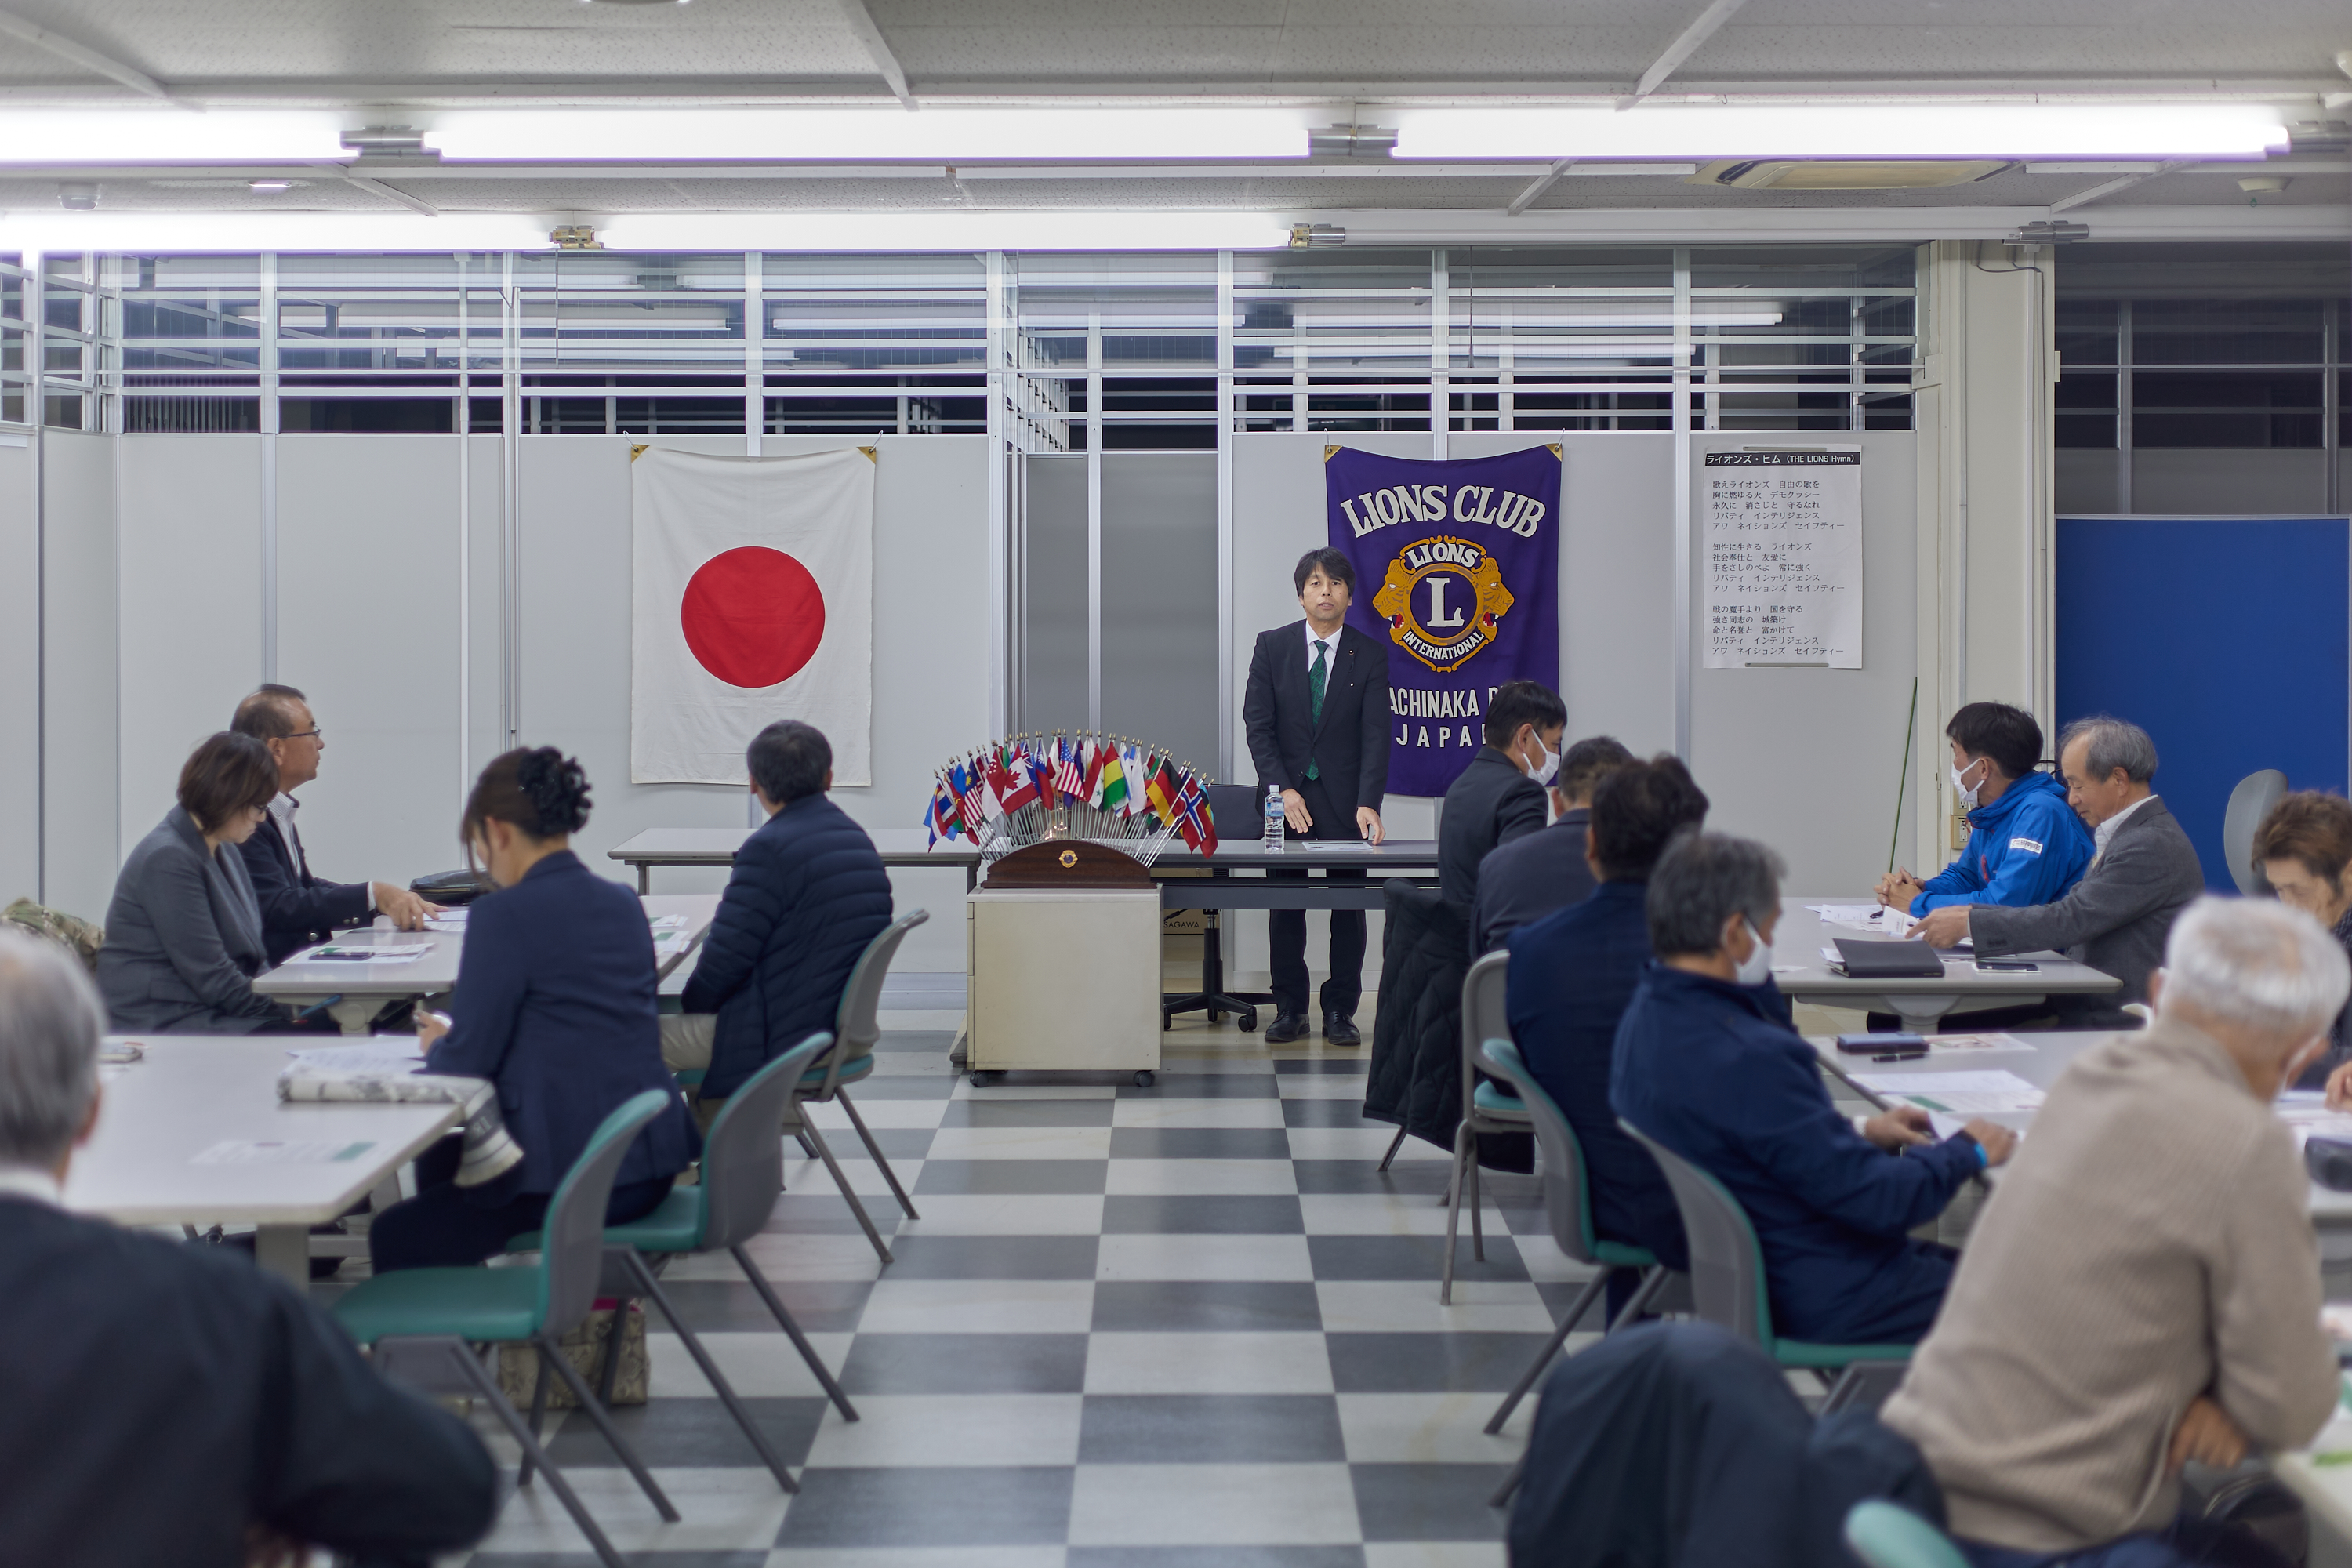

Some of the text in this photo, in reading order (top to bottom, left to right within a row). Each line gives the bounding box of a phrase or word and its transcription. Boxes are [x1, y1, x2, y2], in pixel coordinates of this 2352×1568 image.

[1706, 454, 1781, 464] ライオンズ・ヒム
[1712, 480, 1820, 488] 歌えライオンズ 自由の歌を
[1712, 490, 1820, 499] 胸に燃ゆる火 デモクラシー
[1711, 501, 1820, 510] 永久に 消さじと 守るなれ
[1341, 485, 1546, 539] LIONS CLUB
[1712, 521, 1845, 530] アワ ネイションズ セイフティー
[1712, 543, 1813, 551] 知性に生きる ライオンズ
[1406, 543, 1479, 568] LIONS
[1712, 563, 1812, 572] 手をさしのべよ 常に強く
[1426, 577, 1465, 627] L
[1712, 615, 1787, 624] 強き同志の 城築け
[1712, 626, 1795, 634] 命と名誉と 富かけて
[1402, 630, 1485, 661] INTERNATIONAL
